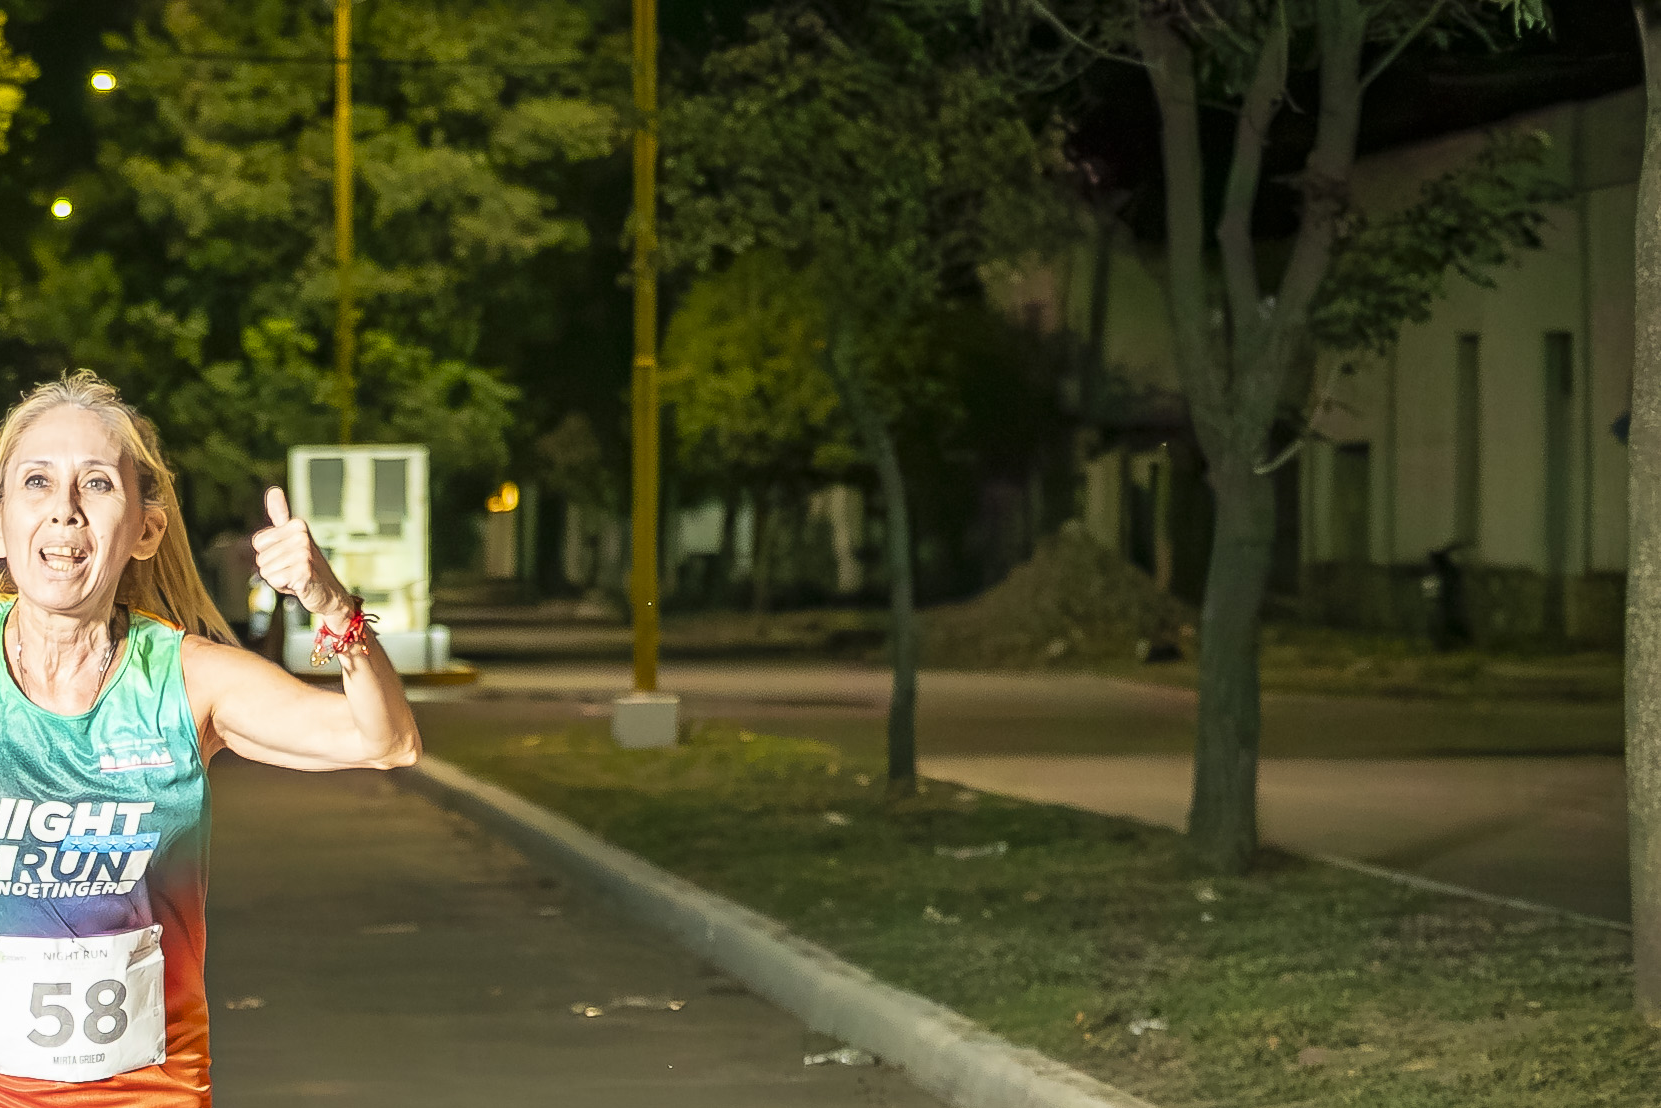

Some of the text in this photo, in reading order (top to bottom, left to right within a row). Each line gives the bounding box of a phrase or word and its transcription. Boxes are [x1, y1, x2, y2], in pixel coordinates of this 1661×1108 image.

[10, 845, 129, 881] RUN
[43, 949, 108, 961] NIGHT RUN
[27, 979, 128, 1048] 58
